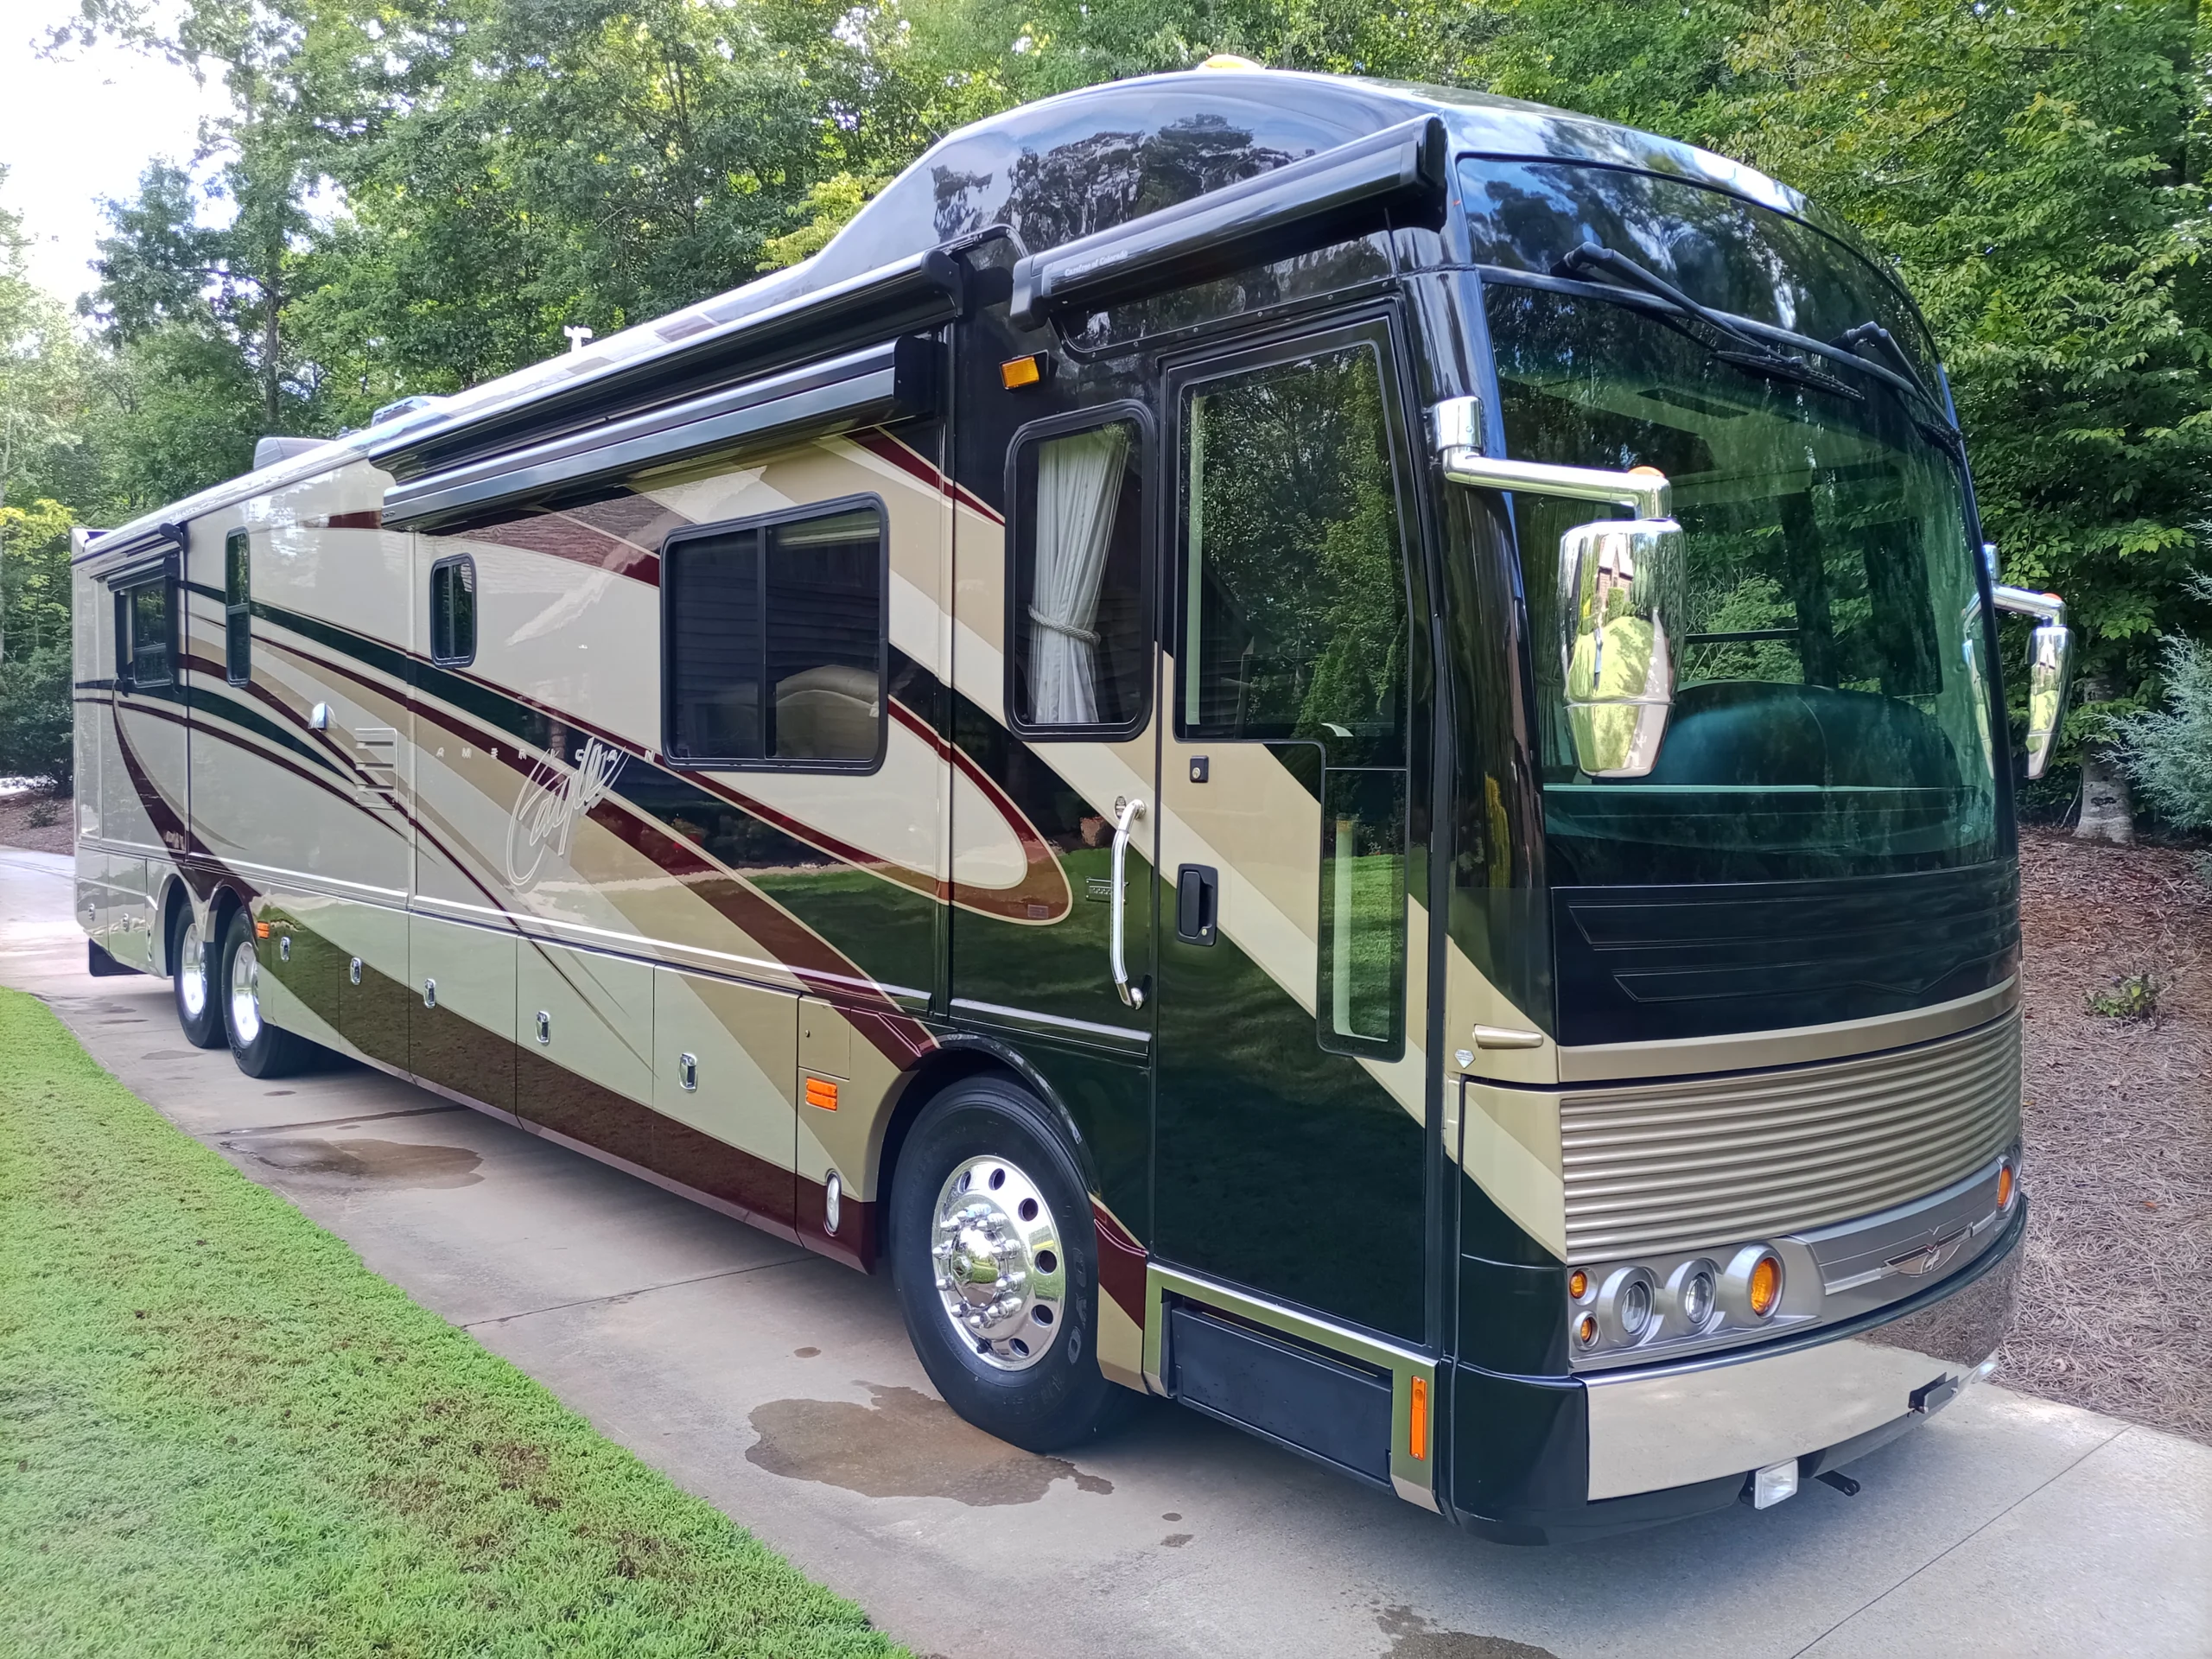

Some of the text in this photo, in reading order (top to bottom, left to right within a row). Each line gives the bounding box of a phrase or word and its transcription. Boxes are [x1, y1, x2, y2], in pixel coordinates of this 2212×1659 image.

[1065, 250, 1128, 277] Carefree of Colorado
